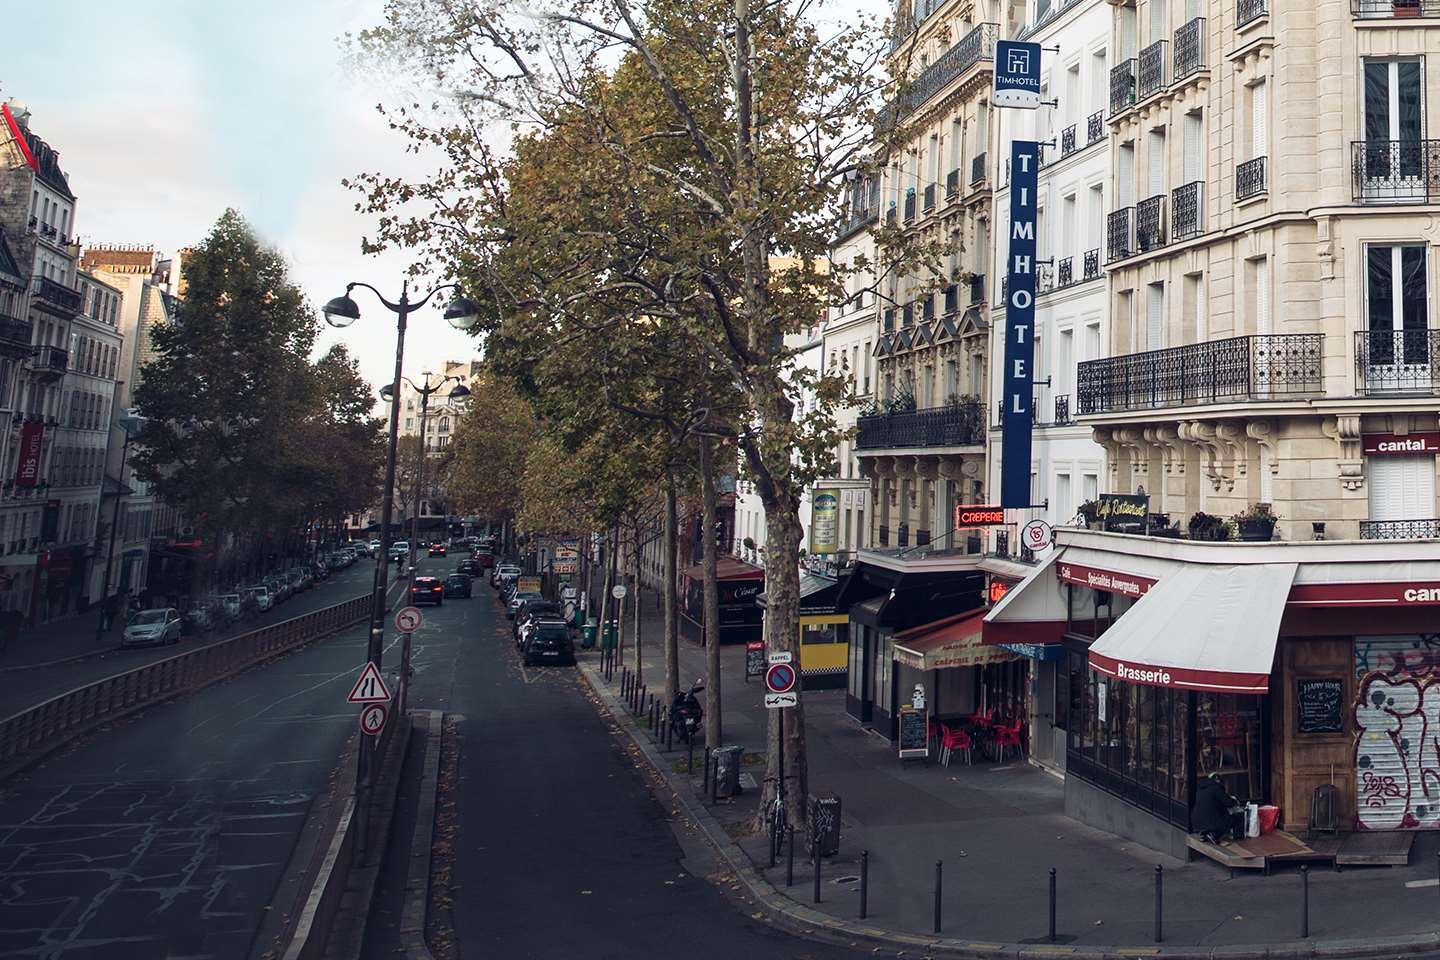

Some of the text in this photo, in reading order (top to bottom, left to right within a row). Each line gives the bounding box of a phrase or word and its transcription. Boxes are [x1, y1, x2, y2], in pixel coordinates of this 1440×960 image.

[997, 76, 1039, 86] TIMHOTEL
[1012, 154, 1034, 414] TIMHOTEL
[1378, 438, 1425, 452] cantal
[21, 458, 37, 478] ibis
[961, 511, 1004, 523] CREPERIE
[1061, 566, 1071, 579] Café
[1087, 572, 1110, 588] Spécialités
[1111, 575, 1140, 595] Auvergnates
[1118, 663, 1171, 685] Brasserie
